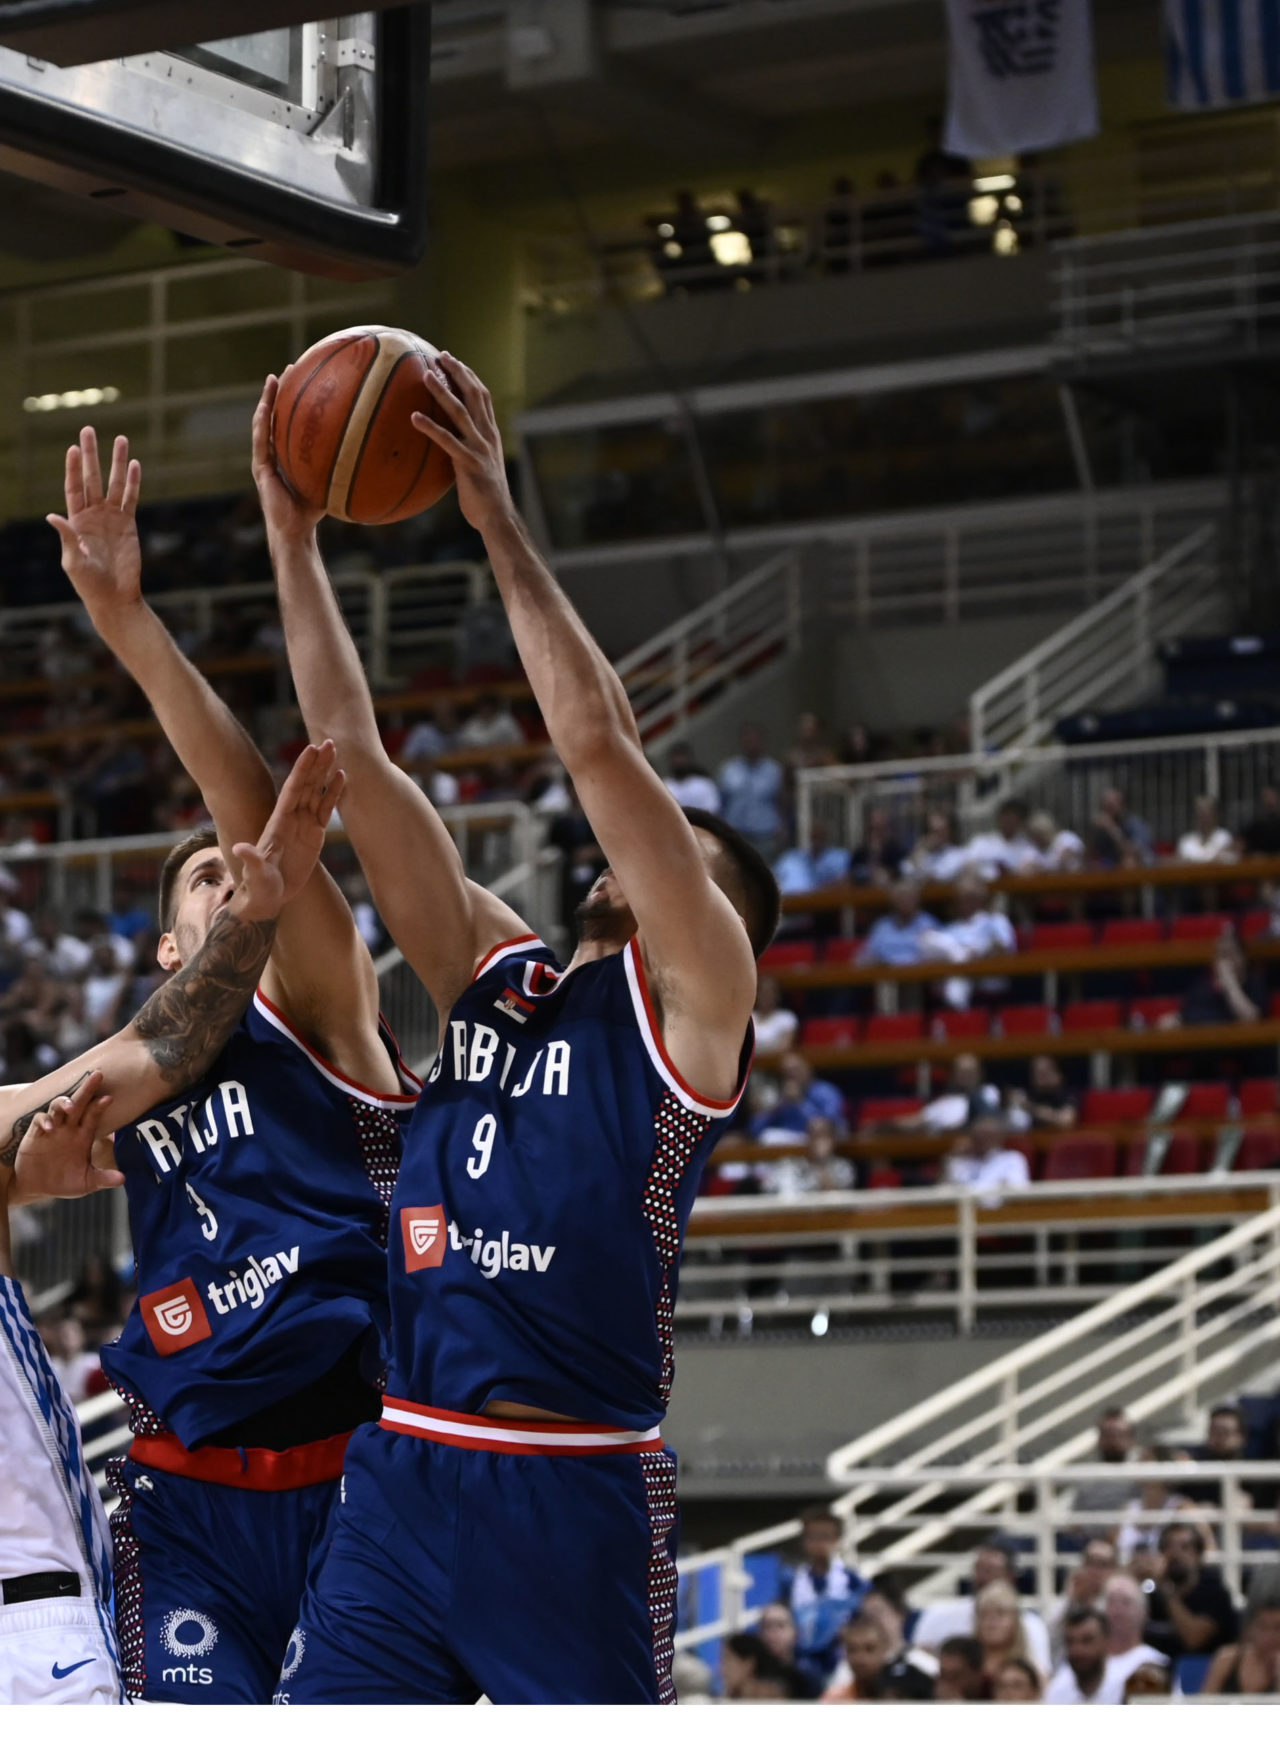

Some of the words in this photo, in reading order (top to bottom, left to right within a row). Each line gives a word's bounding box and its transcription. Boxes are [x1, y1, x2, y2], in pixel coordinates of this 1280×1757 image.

[466, 1113, 497, 1180] 9
[207, 1245, 300, 1315] triglav
[162, 1664, 213, 1684] mts
